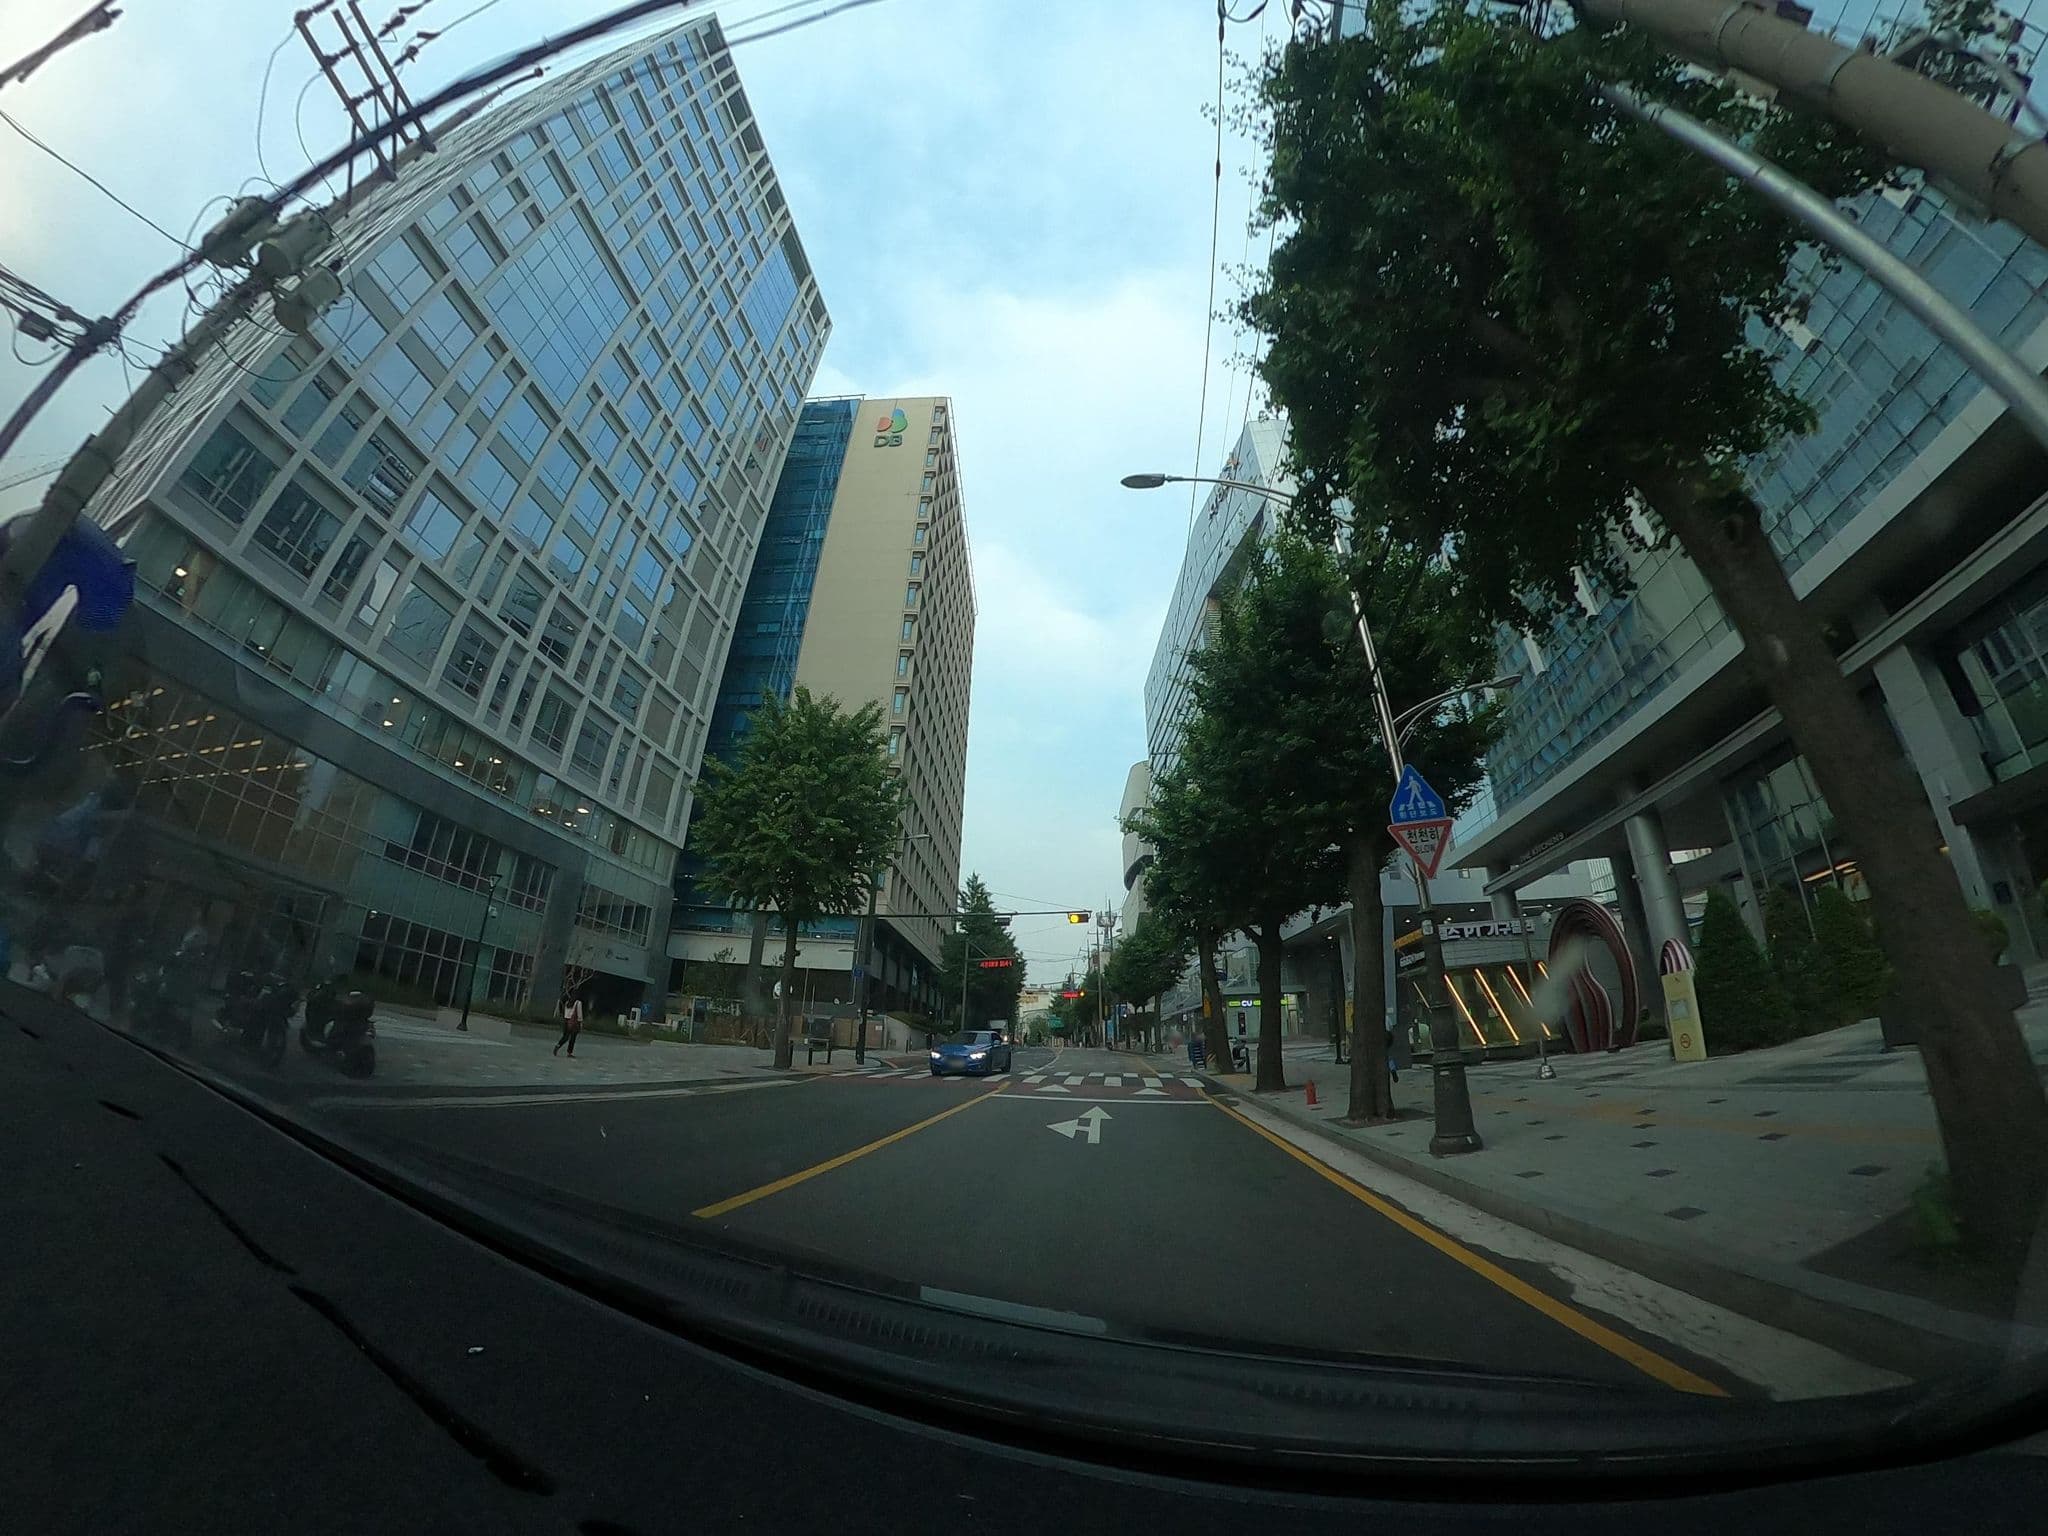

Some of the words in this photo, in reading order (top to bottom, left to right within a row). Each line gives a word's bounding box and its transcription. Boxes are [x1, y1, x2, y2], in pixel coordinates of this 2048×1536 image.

[873, 434, 903, 448] DB
[1406, 826, 1440, 844] 천천히
[1241, 999, 1253, 1007] CU
